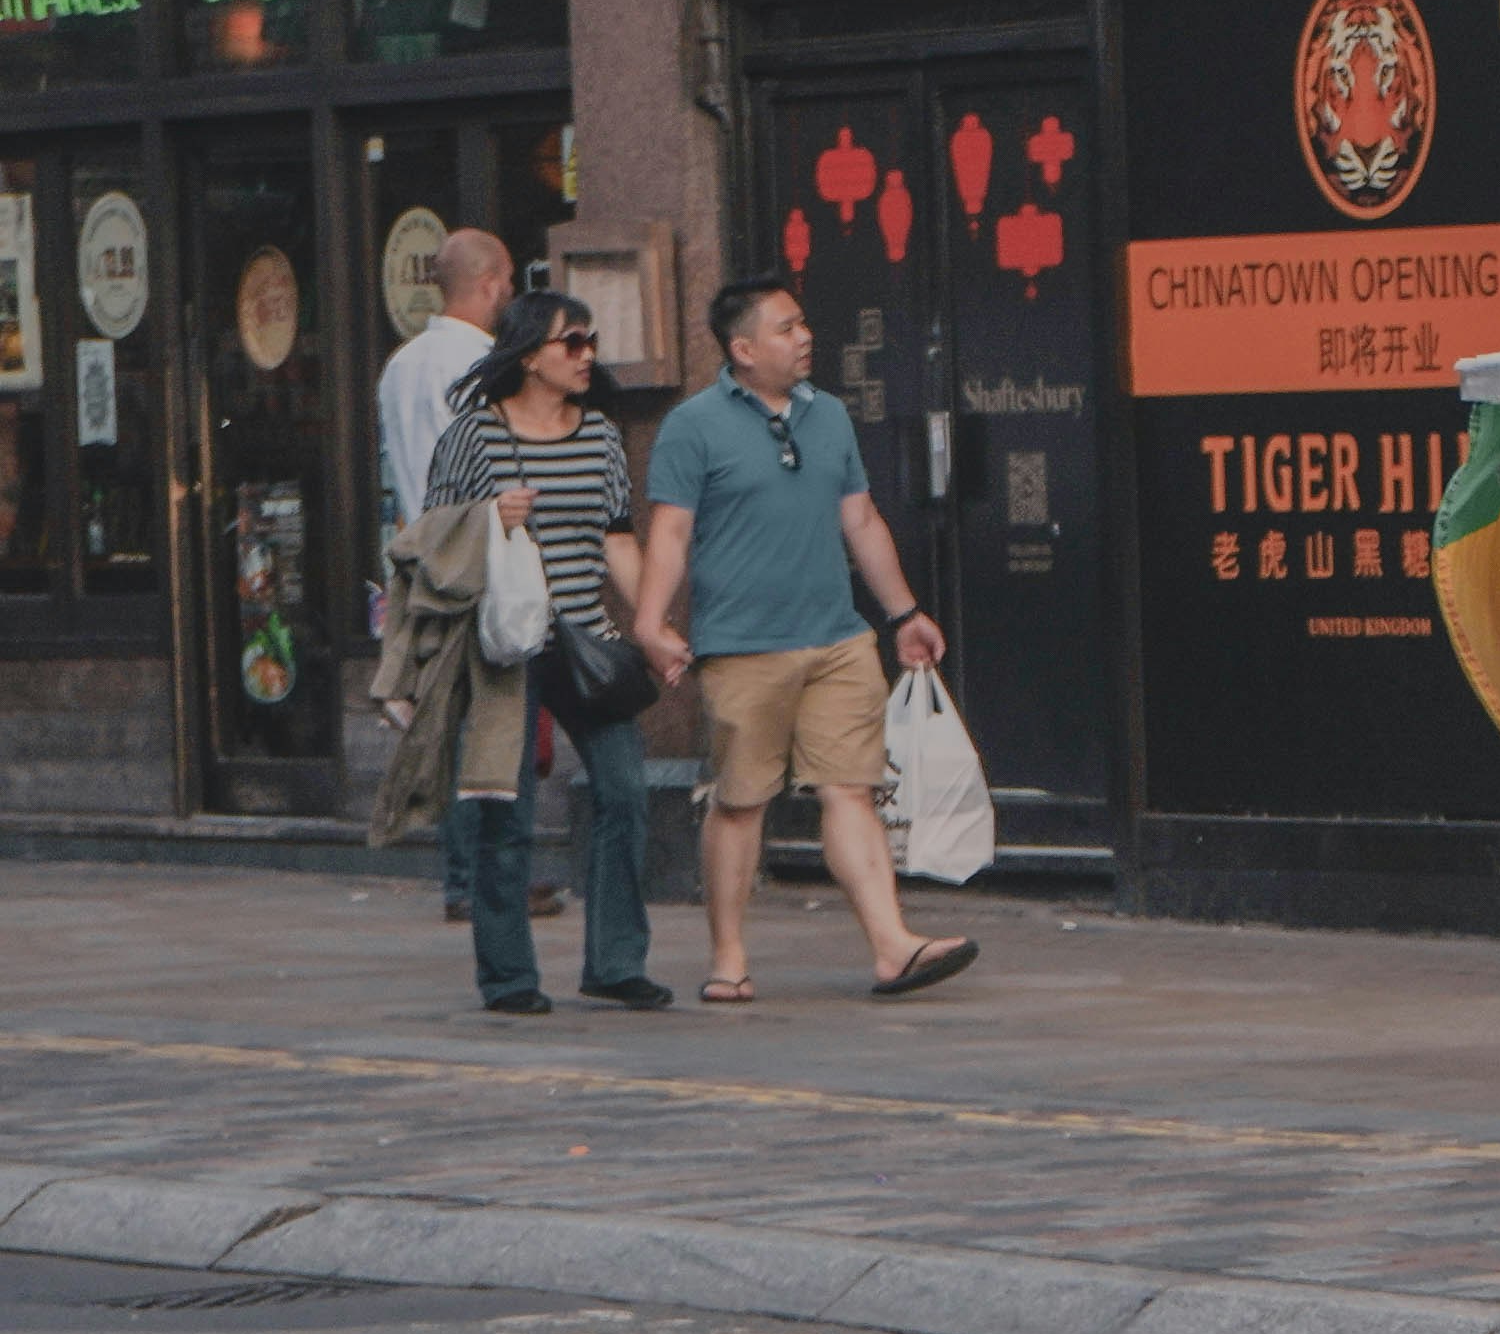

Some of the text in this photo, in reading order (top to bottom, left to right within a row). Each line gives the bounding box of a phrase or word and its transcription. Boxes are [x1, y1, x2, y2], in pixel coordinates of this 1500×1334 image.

[1148, 259, 1339, 310] CHINATOWN
[1351, 251, 1498, 303] OPENING
[1318, 321, 1443, 376] 即将开业
[962, 374, 1085, 417] Shaftesbury
[1201, 433, 1361, 514] TIGER
[1308, 617, 1432, 636] UNITED KINGDOM
